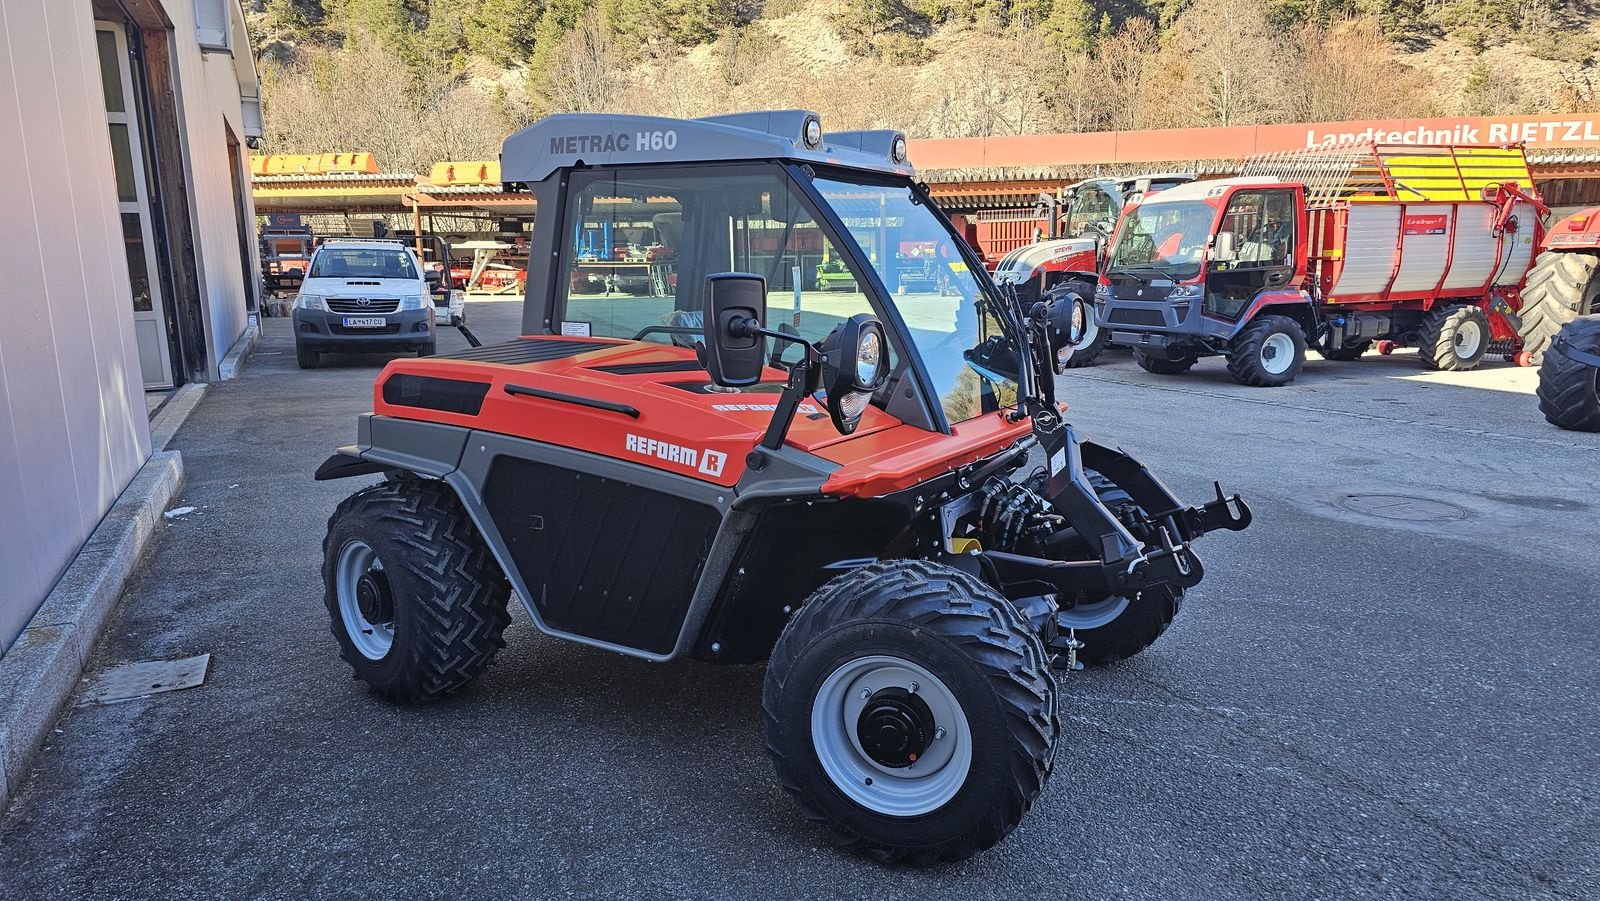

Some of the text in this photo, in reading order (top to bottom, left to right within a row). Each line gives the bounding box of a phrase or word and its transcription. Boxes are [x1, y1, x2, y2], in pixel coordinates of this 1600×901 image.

[550, 130, 678, 155] METRAC H60
[1306, 120, 1600, 147] Landtechnik RIETZL
[1054, 245, 1073, 254] STEYR
[625, 433, 698, 467] REFORM
